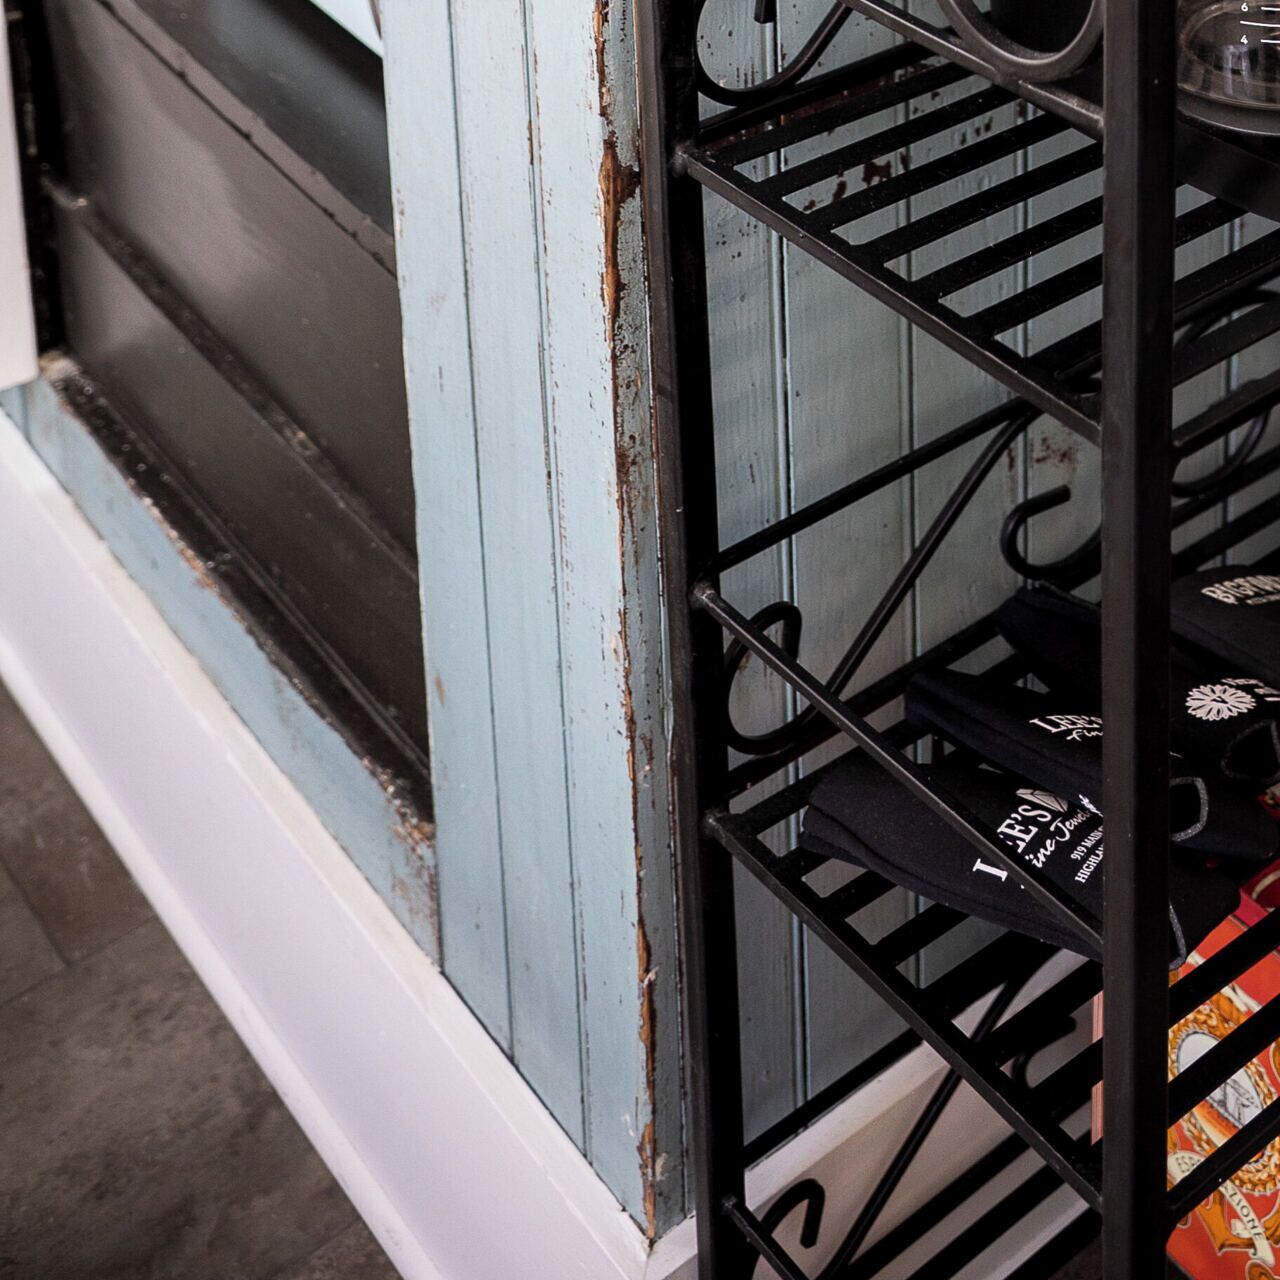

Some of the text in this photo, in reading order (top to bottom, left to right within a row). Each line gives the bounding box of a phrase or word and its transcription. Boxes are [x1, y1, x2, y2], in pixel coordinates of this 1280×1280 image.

[1241, 2, 1249, 12] 6
[1240, 33, 1249, 45] 4
[1070, 845, 1087, 861] 919
